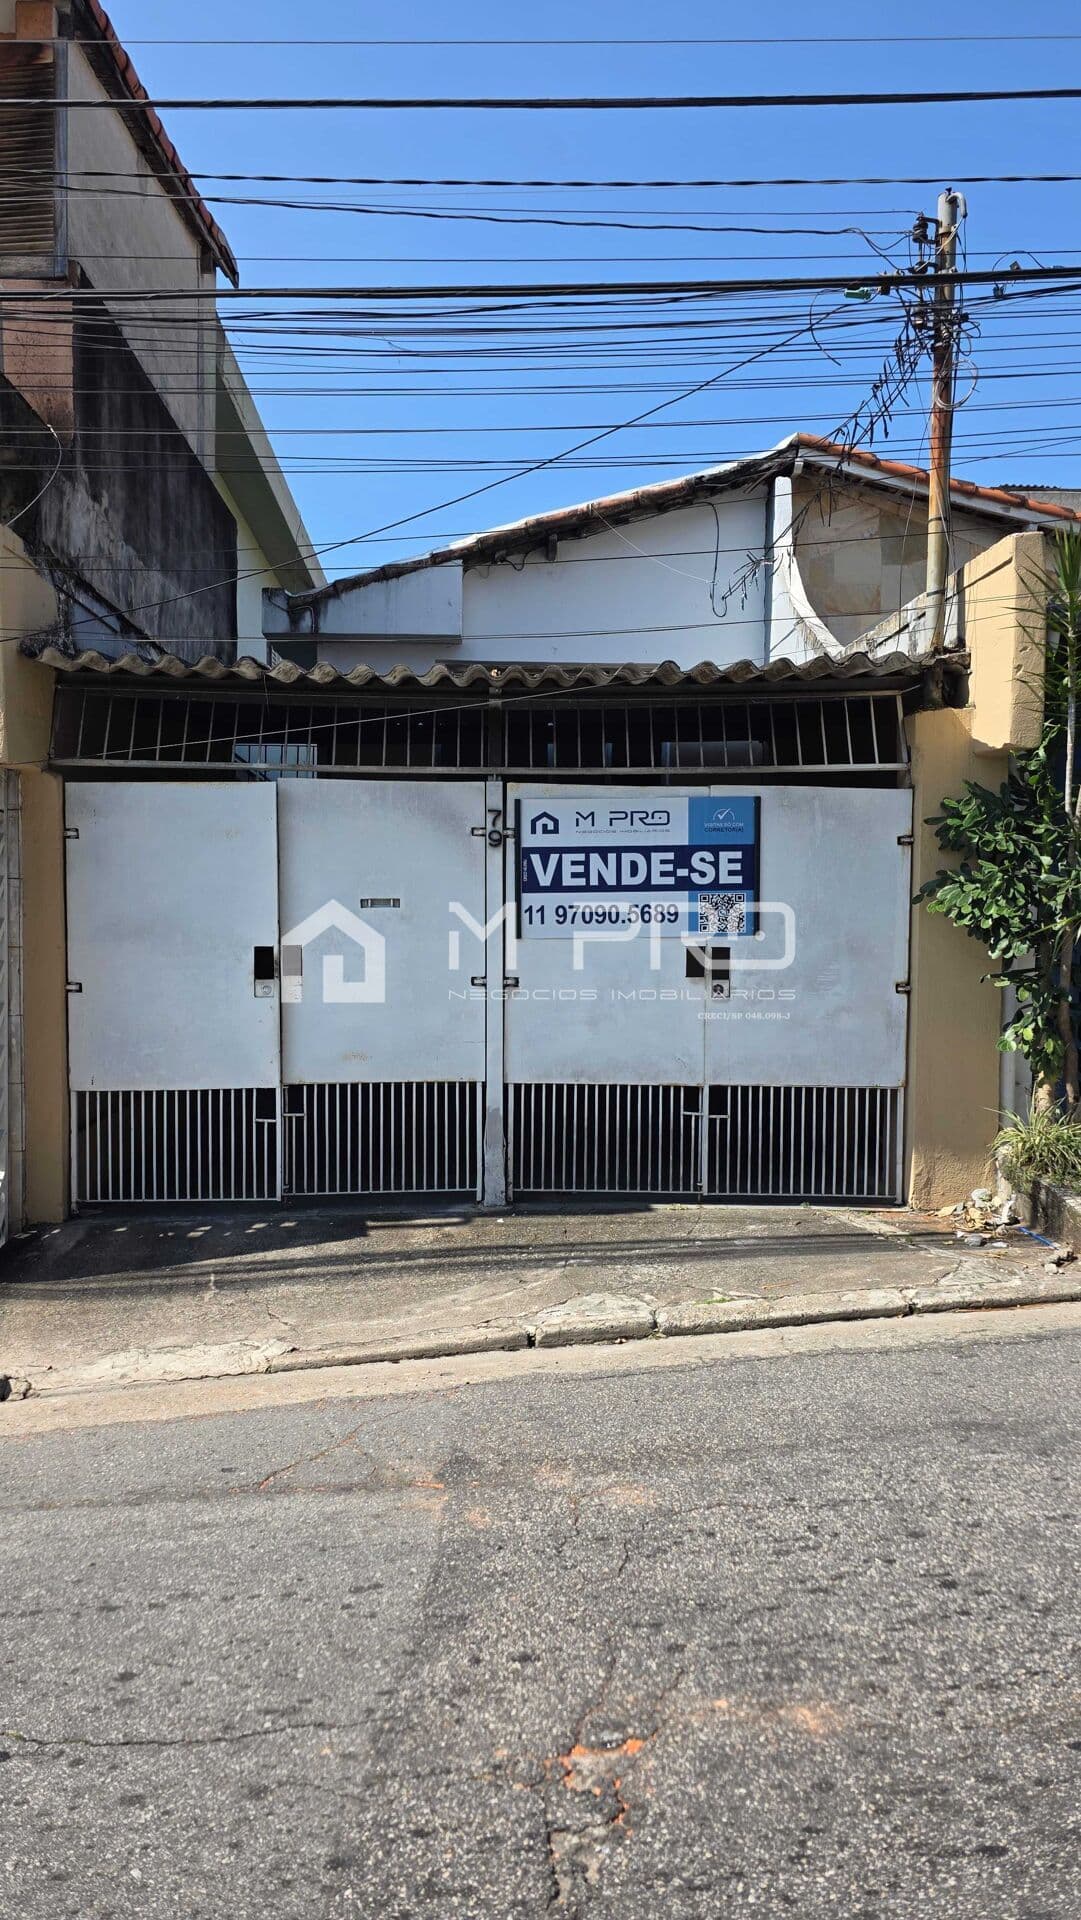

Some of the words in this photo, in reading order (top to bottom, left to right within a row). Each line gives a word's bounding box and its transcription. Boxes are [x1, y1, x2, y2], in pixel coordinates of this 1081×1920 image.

[488, 809, 502, 847] 79
[575, 811, 595, 827] M
[609, 810, 670, 826] PRO
[530, 851, 743, 886] VENDE-SE
[524, 905, 545, 925] 11
[554, 904, 679, 925] 97090.5689
